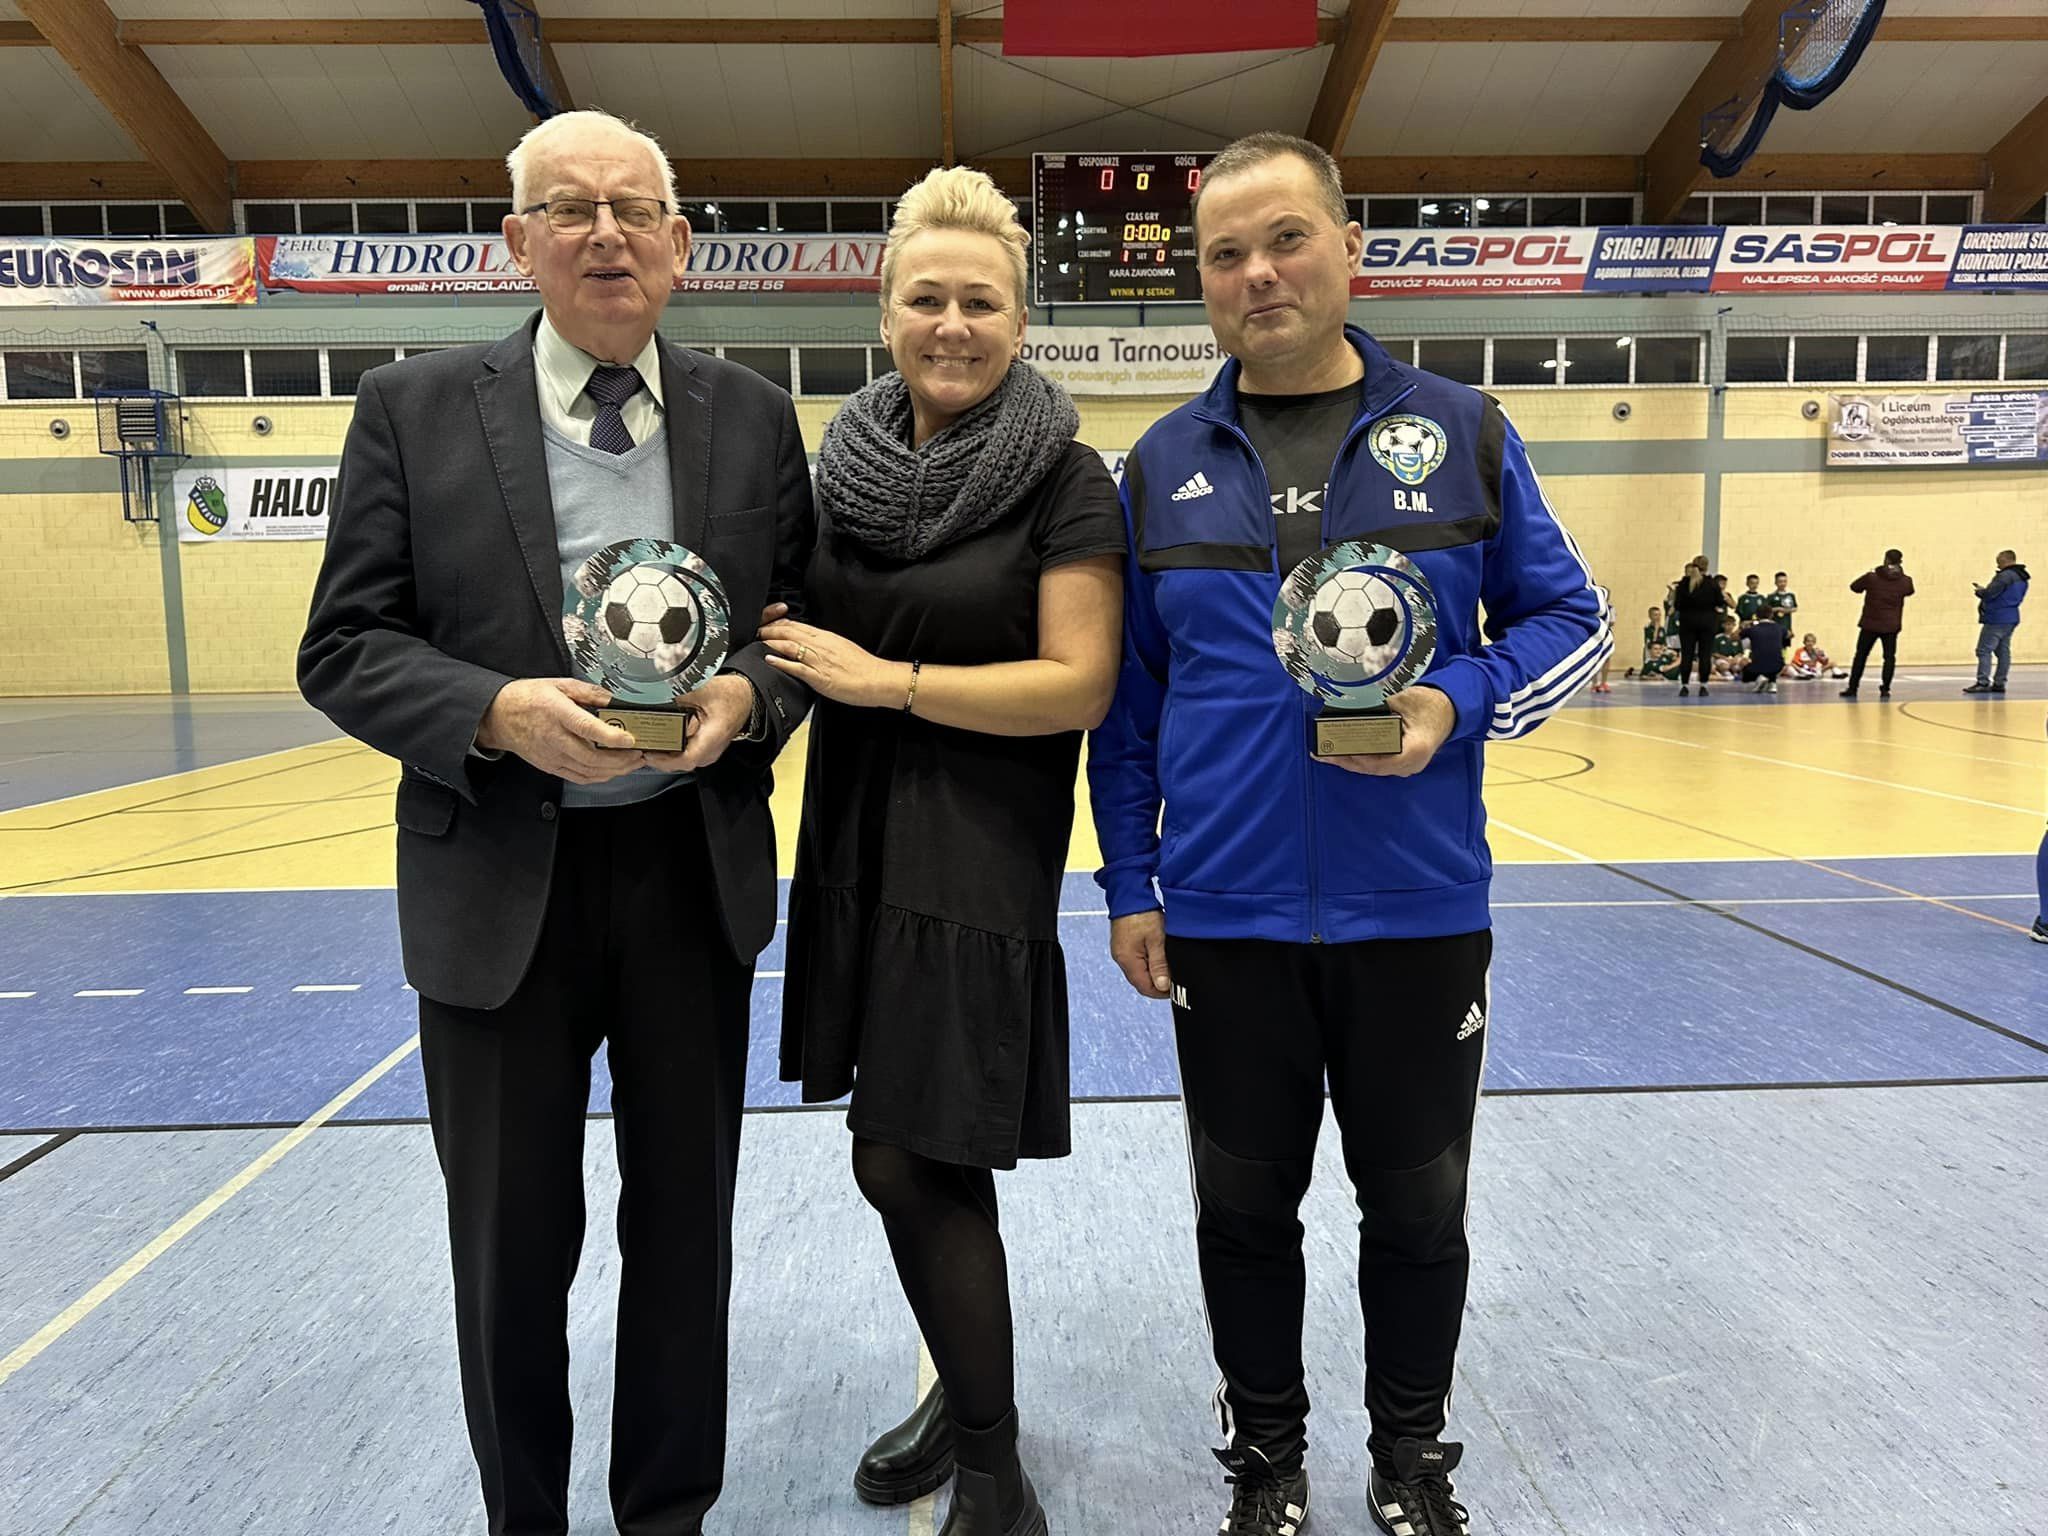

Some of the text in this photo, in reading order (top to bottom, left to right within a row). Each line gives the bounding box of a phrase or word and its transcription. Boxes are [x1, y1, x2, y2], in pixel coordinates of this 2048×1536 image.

[1079, 156, 1120, 167] GOSPODARZE
[1101, 169, 1114, 190] 0
[1136, 172, 1149, 190] 0
[1125, 212, 1160, 221] CZAS GRY
[290, 239, 330, 252] F.H.U.
[1600, 236, 1719, 261] STACJA PALIW
[1730, 233, 1947, 264] SASPOL
[1963, 232, 2030, 252] OKRĘGOWA
[1156, 249, 1166, 262] 0
[1362, 235, 1584, 267] SASPOL
[0, 247, 201, 288] EUROSAN
[1956, 253, 2015, 270] KONTROLI
[1109, 268, 1176, 278] KARA ZAWODNIKA
[1742, 273, 1924, 284] NAJLEPSZA JAKOŚĆ PALIW
[387, 280, 430, 292] email:
[681, 280, 785, 290] 14 642 25 56
[1370, 277, 1562, 288] DOWÓZ PALIWA DO KLIENTA
[119, 286, 231, 299] www.eurosan.pl
[1110, 288, 1176, 297] WYNIK W SETACH
[1888, 402, 1931, 413] Liceum
[1882, 415, 1965, 426] Ogólnokształcące
[250, 478, 337, 518] HALO
[1171, 483, 1214, 501] adidas
[1393, 489, 1434, 513] B.M.
[1456, 1015, 1485, 1040] adidas
